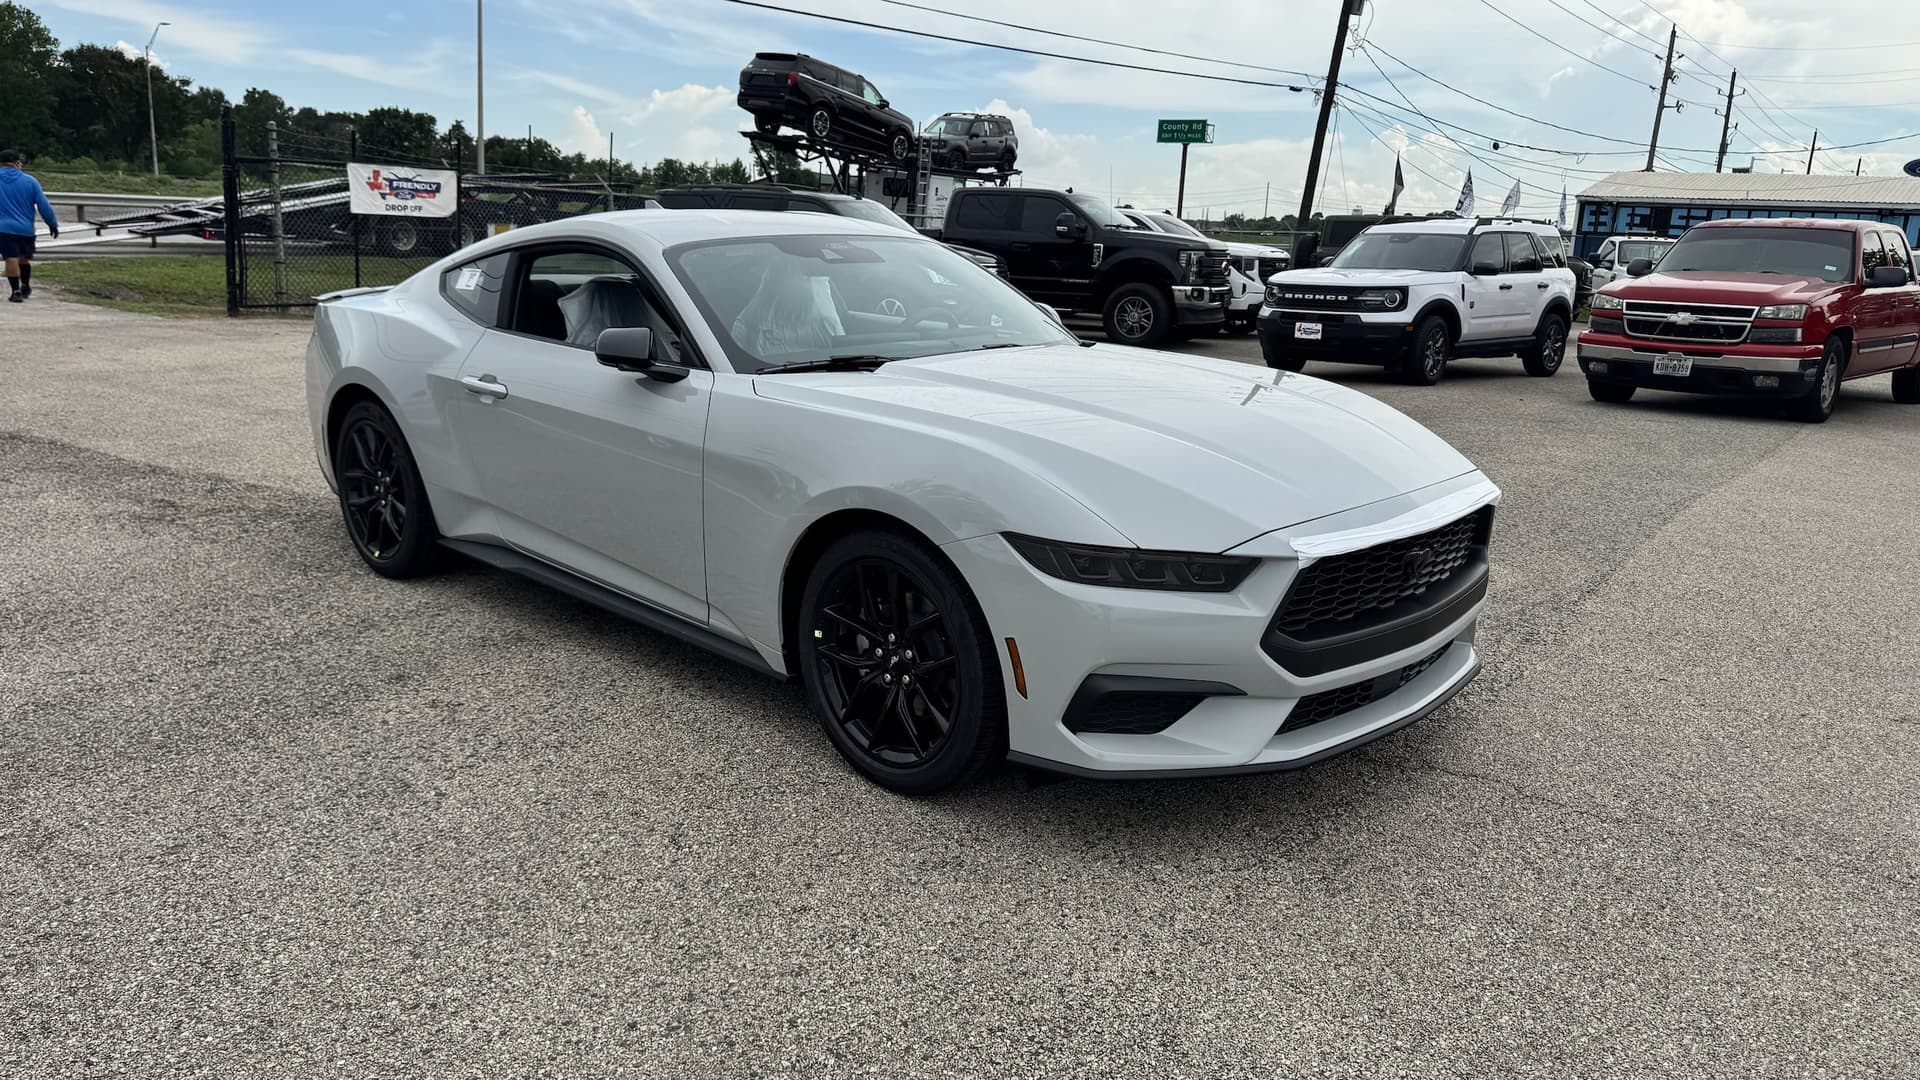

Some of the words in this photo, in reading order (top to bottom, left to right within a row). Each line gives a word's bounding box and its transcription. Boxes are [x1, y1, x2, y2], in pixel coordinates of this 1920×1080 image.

[1162, 123, 1189, 132] County
[392, 181, 438, 190] FRIENDLY
[385, 204, 409, 212] DROP
[1284, 293, 1348, 301] BRONCO
